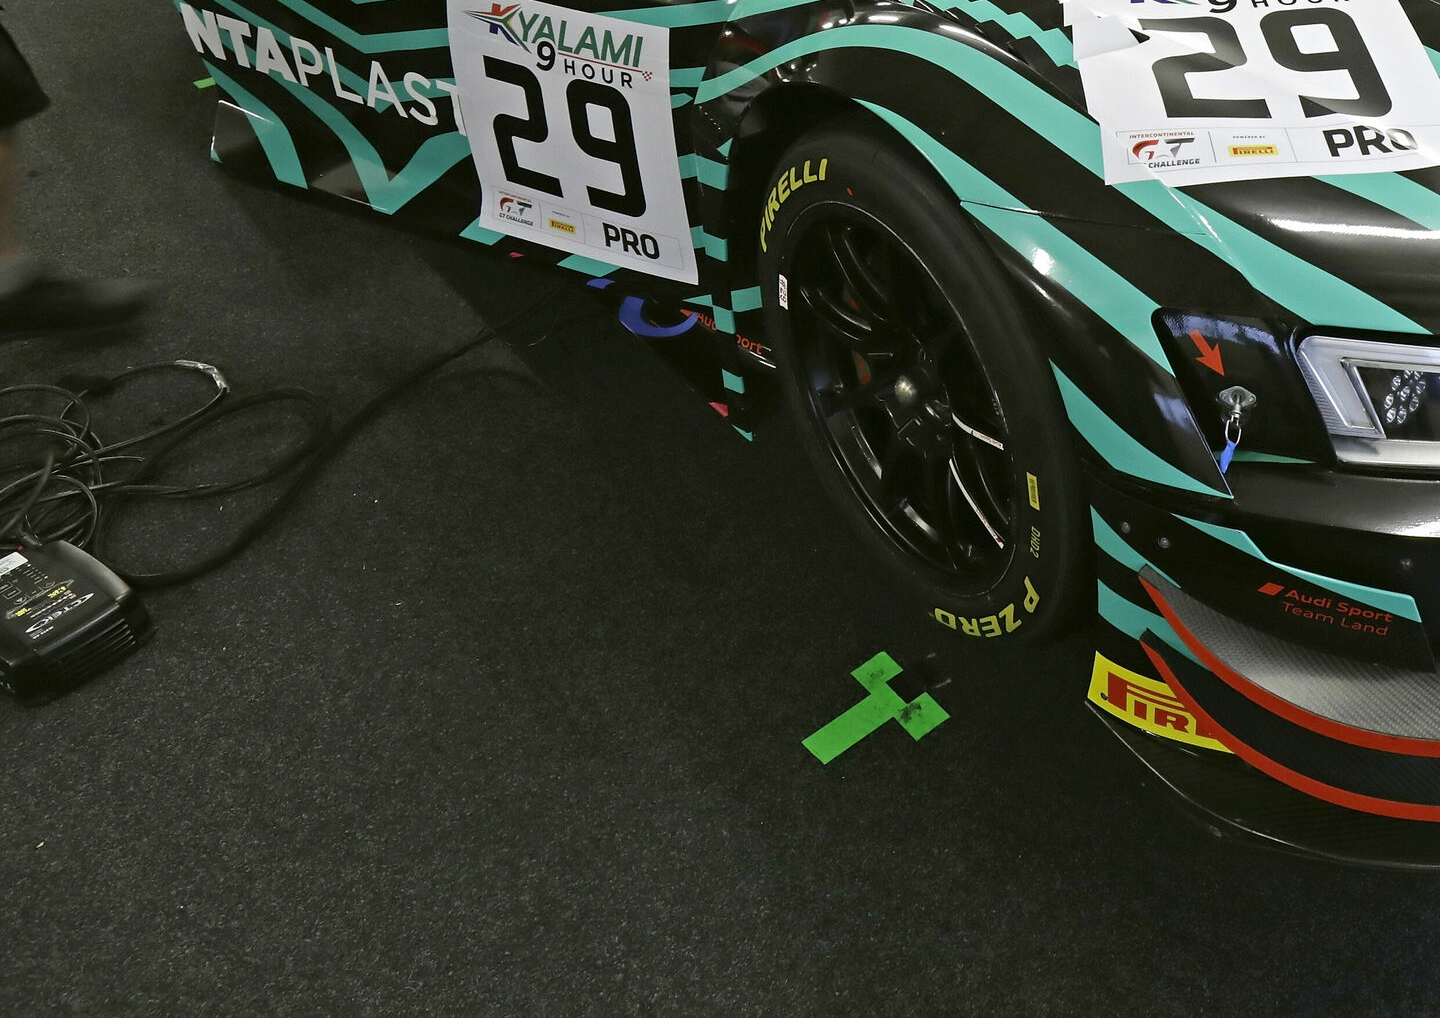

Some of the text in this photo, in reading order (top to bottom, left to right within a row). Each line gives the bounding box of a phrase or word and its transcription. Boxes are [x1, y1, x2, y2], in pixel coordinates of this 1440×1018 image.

[486, 2, 644, 68] KYALAMI
[536, 40, 633, 89] 9 HOUR
[1138, 7, 1394, 119] 29
[483, 55, 647, 218] 29
[1129, 131, 1195, 139] INTERCONTINENTAL
[1322, 125, 1418, 157] PRO
[1148, 158, 1200, 169] CHALLENGE
[760, 158, 828, 253] PIRELLI
[602, 222, 660, 260] PRO
[934, 576, 1040, 638] P ZERO
[1282, 601, 1389, 636] Team Land
[1285, 589, 1394, 623] Audi Sport
